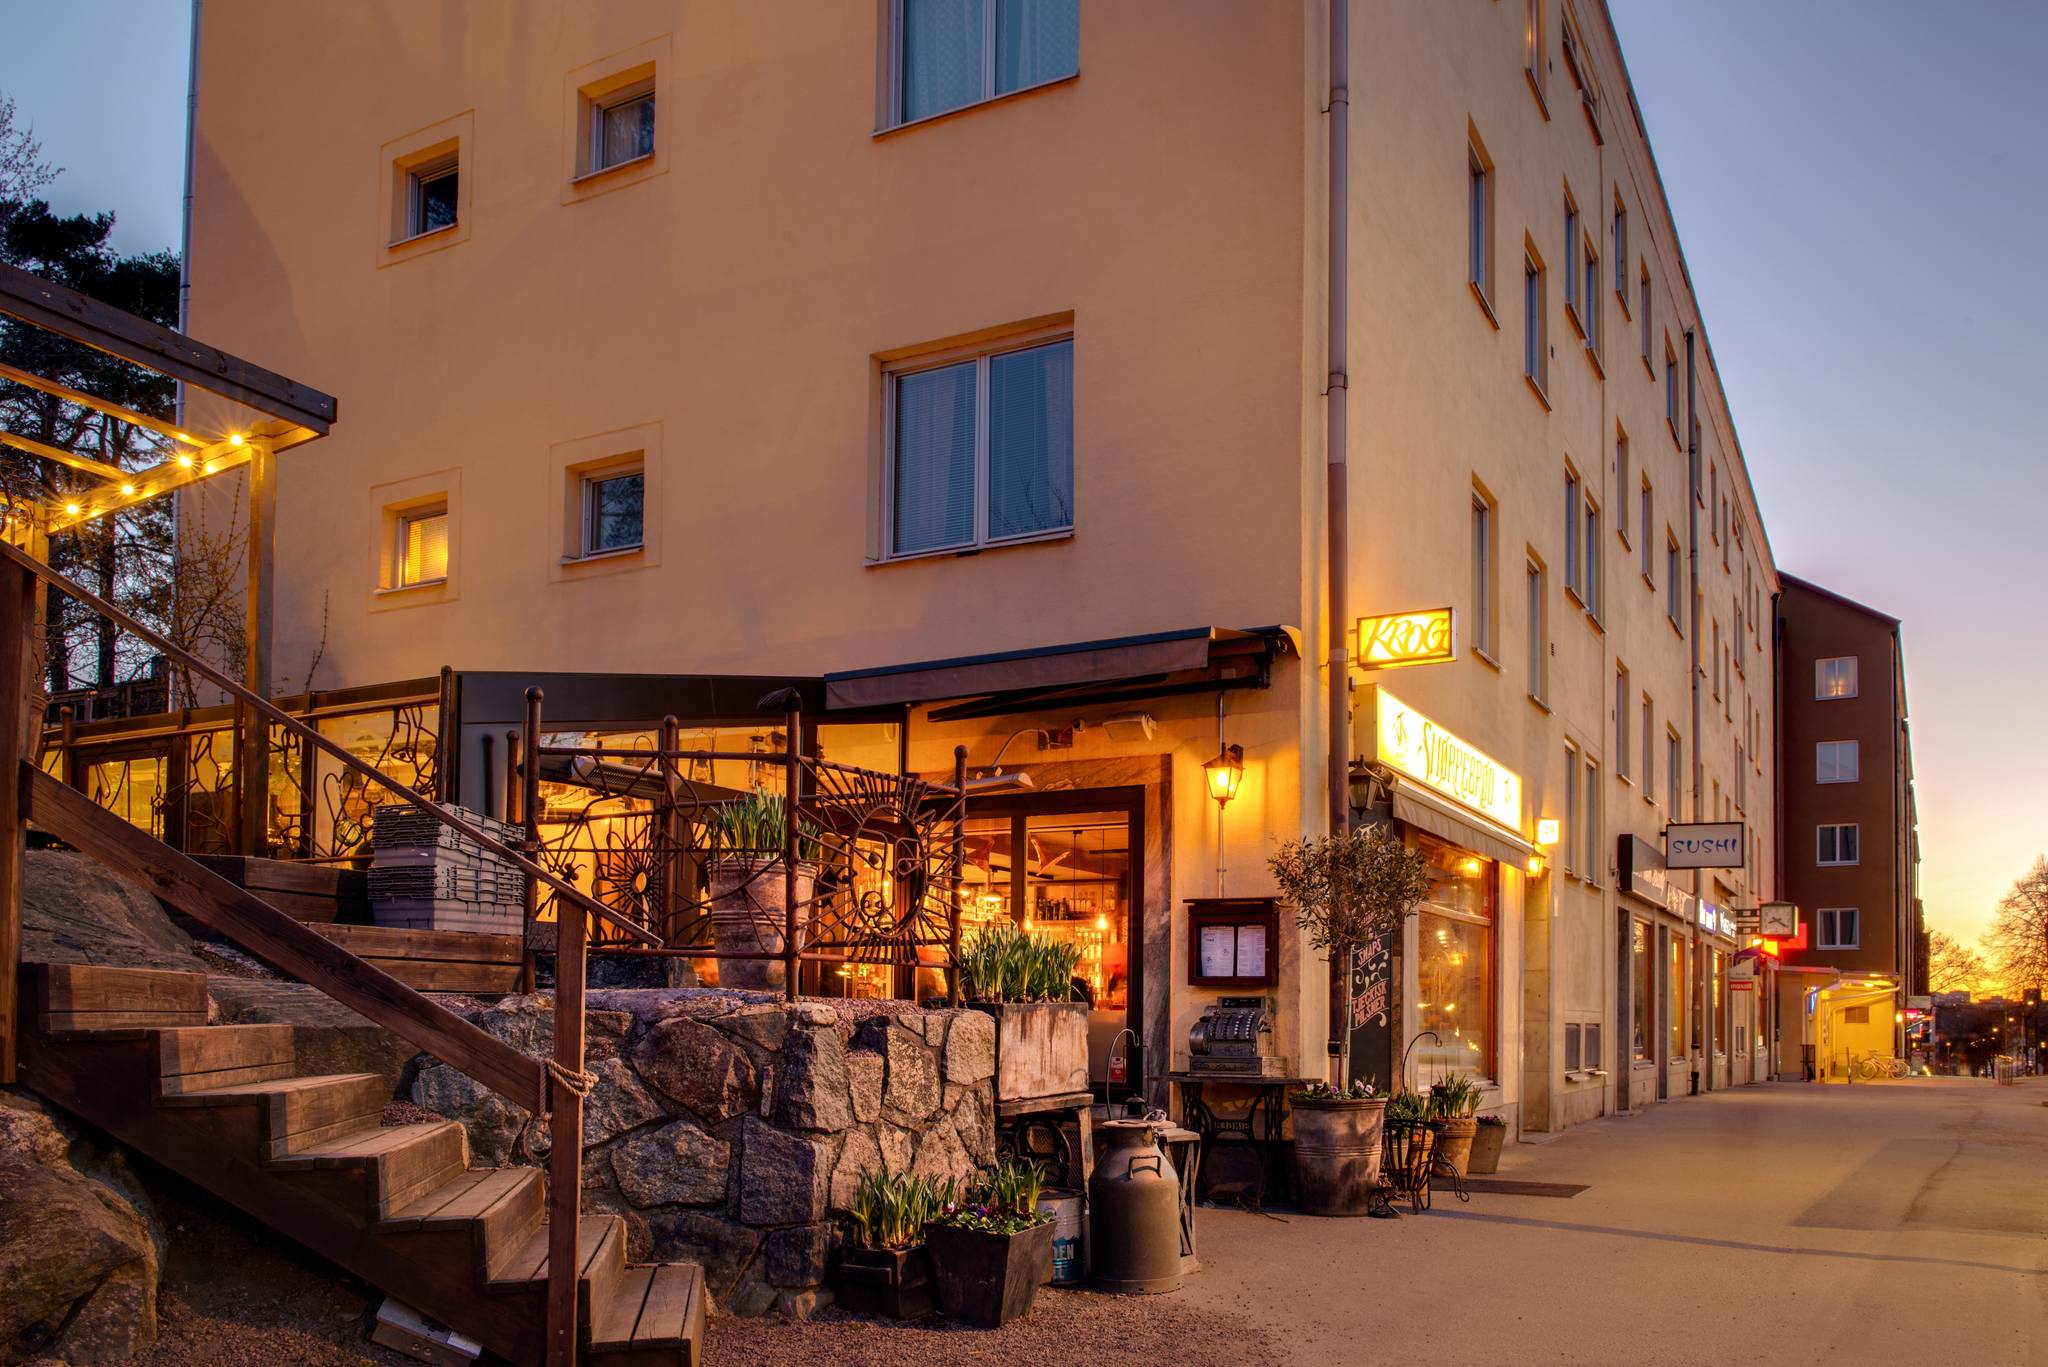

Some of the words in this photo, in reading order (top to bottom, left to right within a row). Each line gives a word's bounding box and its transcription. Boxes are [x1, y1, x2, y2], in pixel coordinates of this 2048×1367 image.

[1361, 615, 1449, 661] KROG
[1673, 839, 1737, 853] SUSHI
[1358, 938, 1382, 966] SNAPS
[1352, 981, 1387, 1014] TJECKISK
[1355, 996, 1386, 1027] PILSNER
